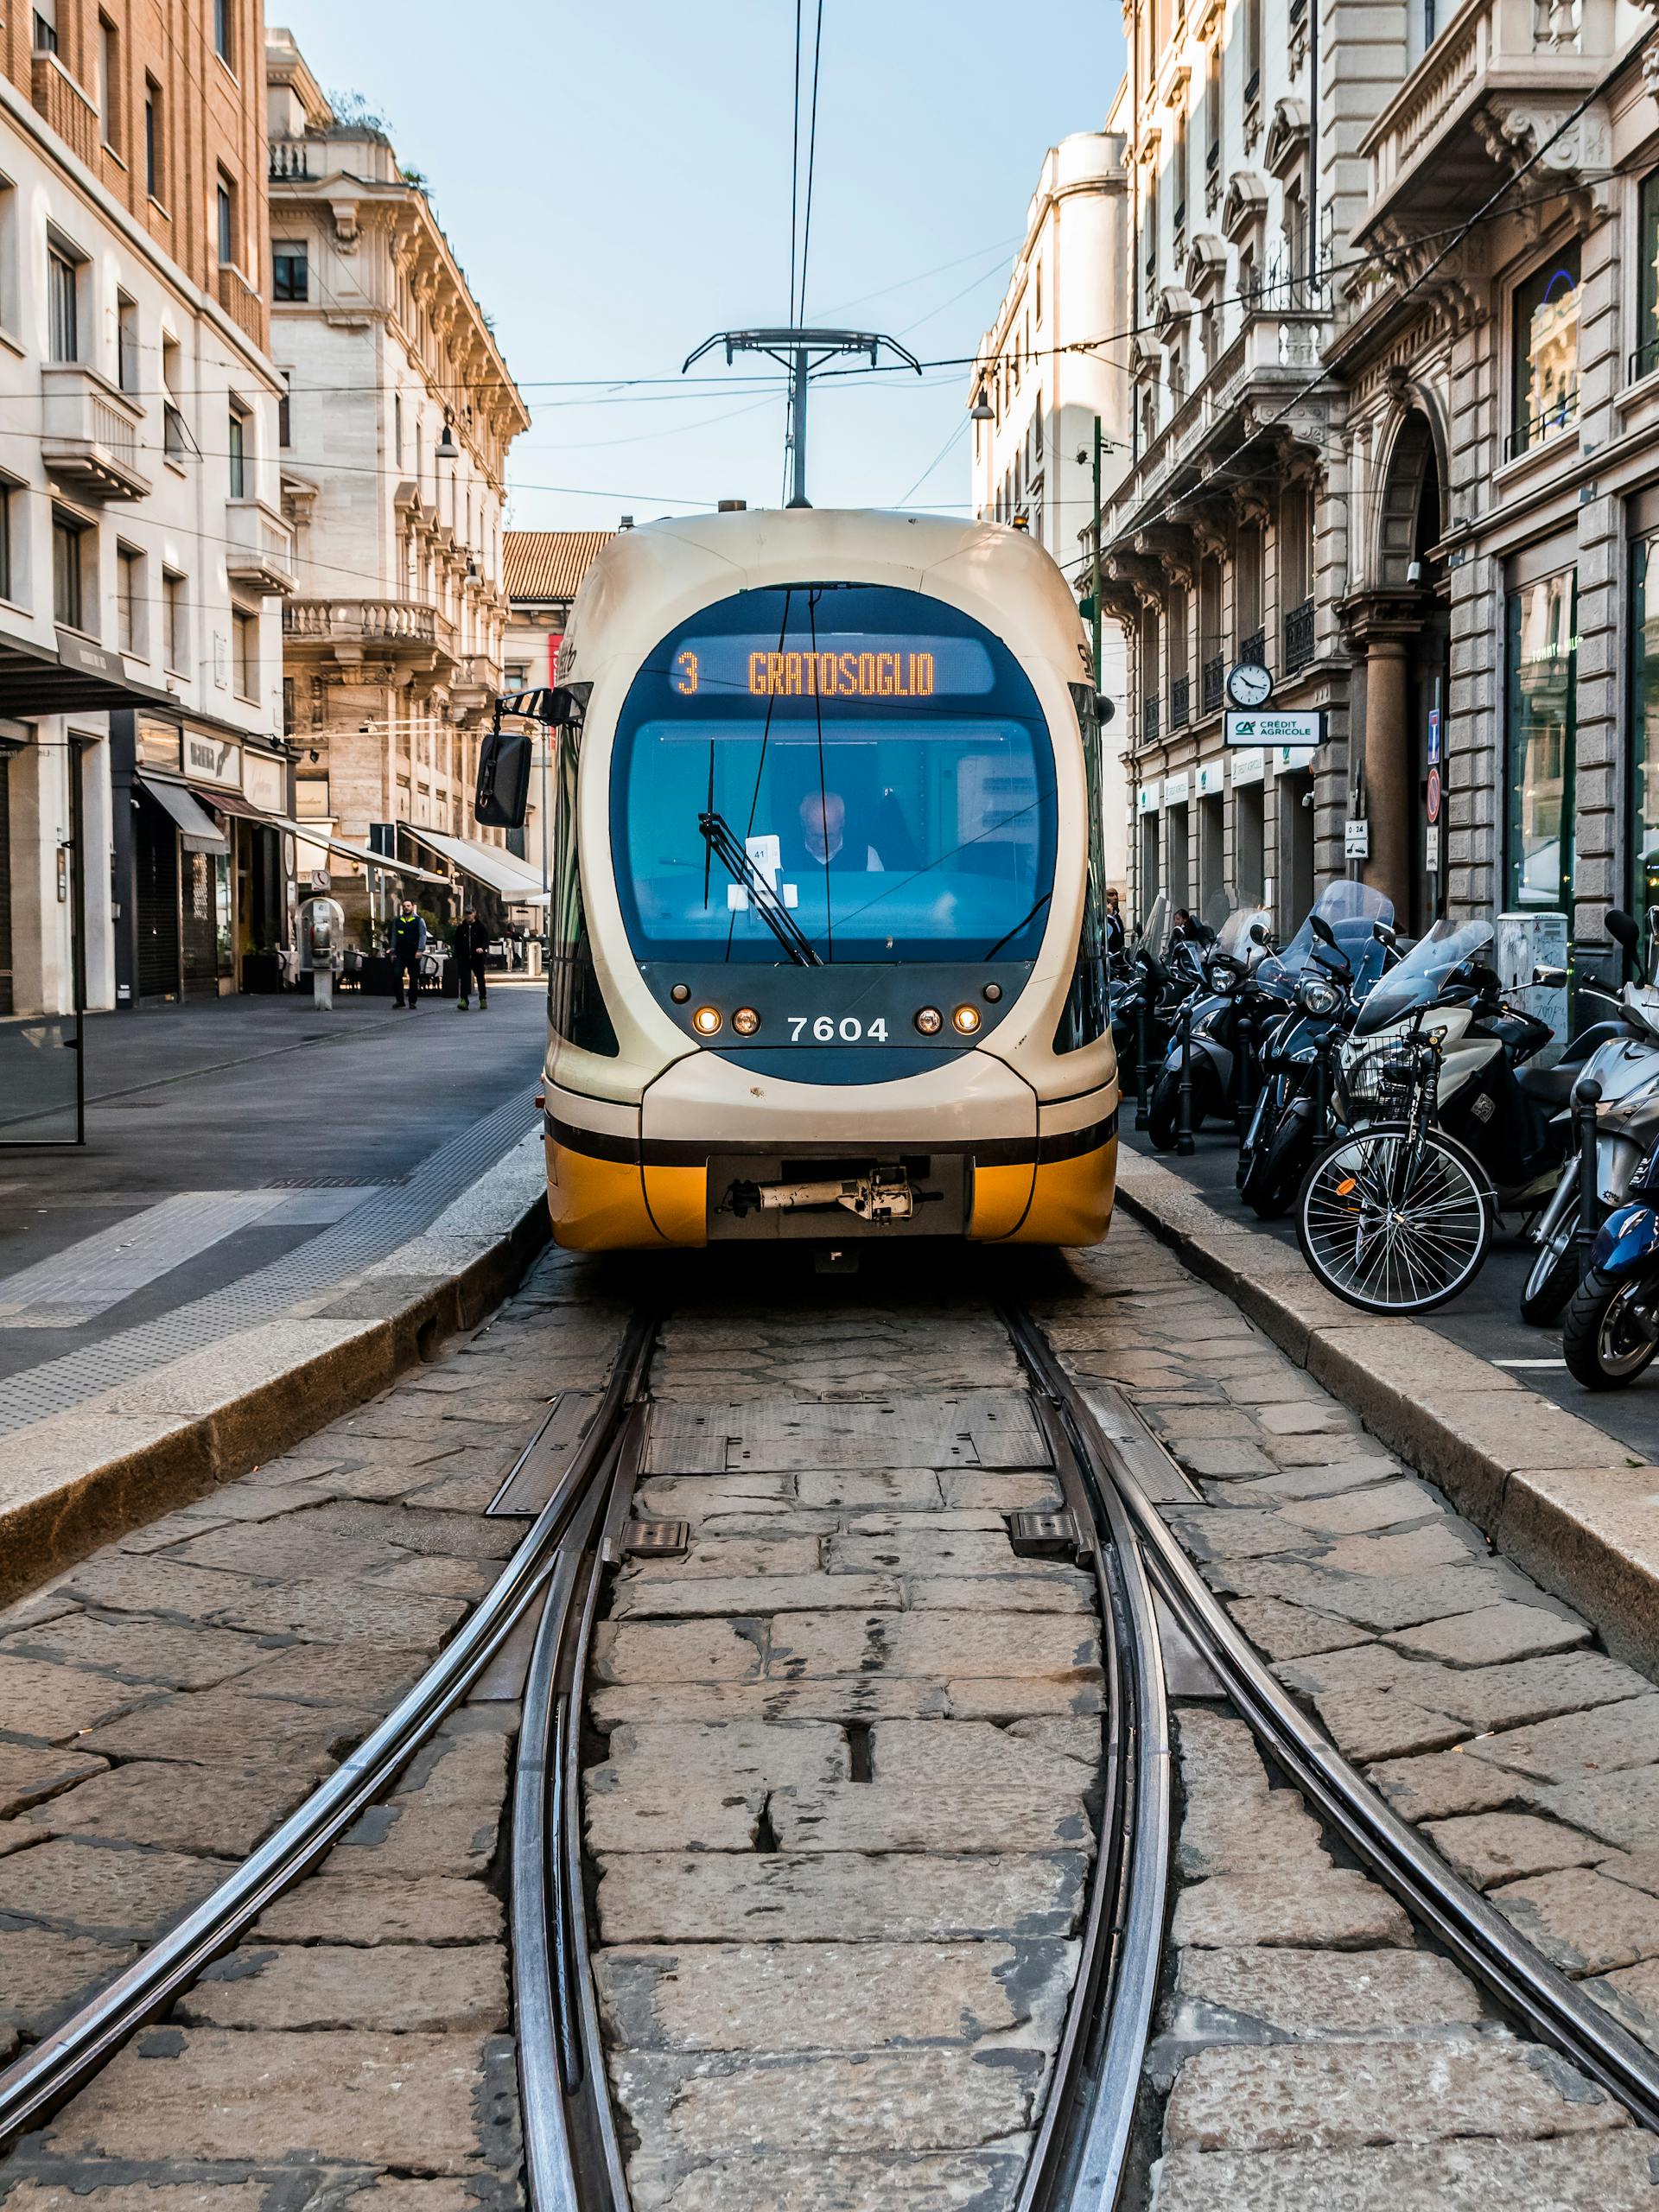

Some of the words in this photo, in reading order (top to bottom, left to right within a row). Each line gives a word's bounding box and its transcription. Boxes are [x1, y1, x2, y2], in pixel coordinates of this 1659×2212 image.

[678, 652, 698, 695] 3
[749, 652, 934, 696] GRATOSOGLIO
[1260, 719, 1298, 728] CRÉDIT
[754, 850, 765, 859] 41
[787, 1015, 889, 1042] 7604
